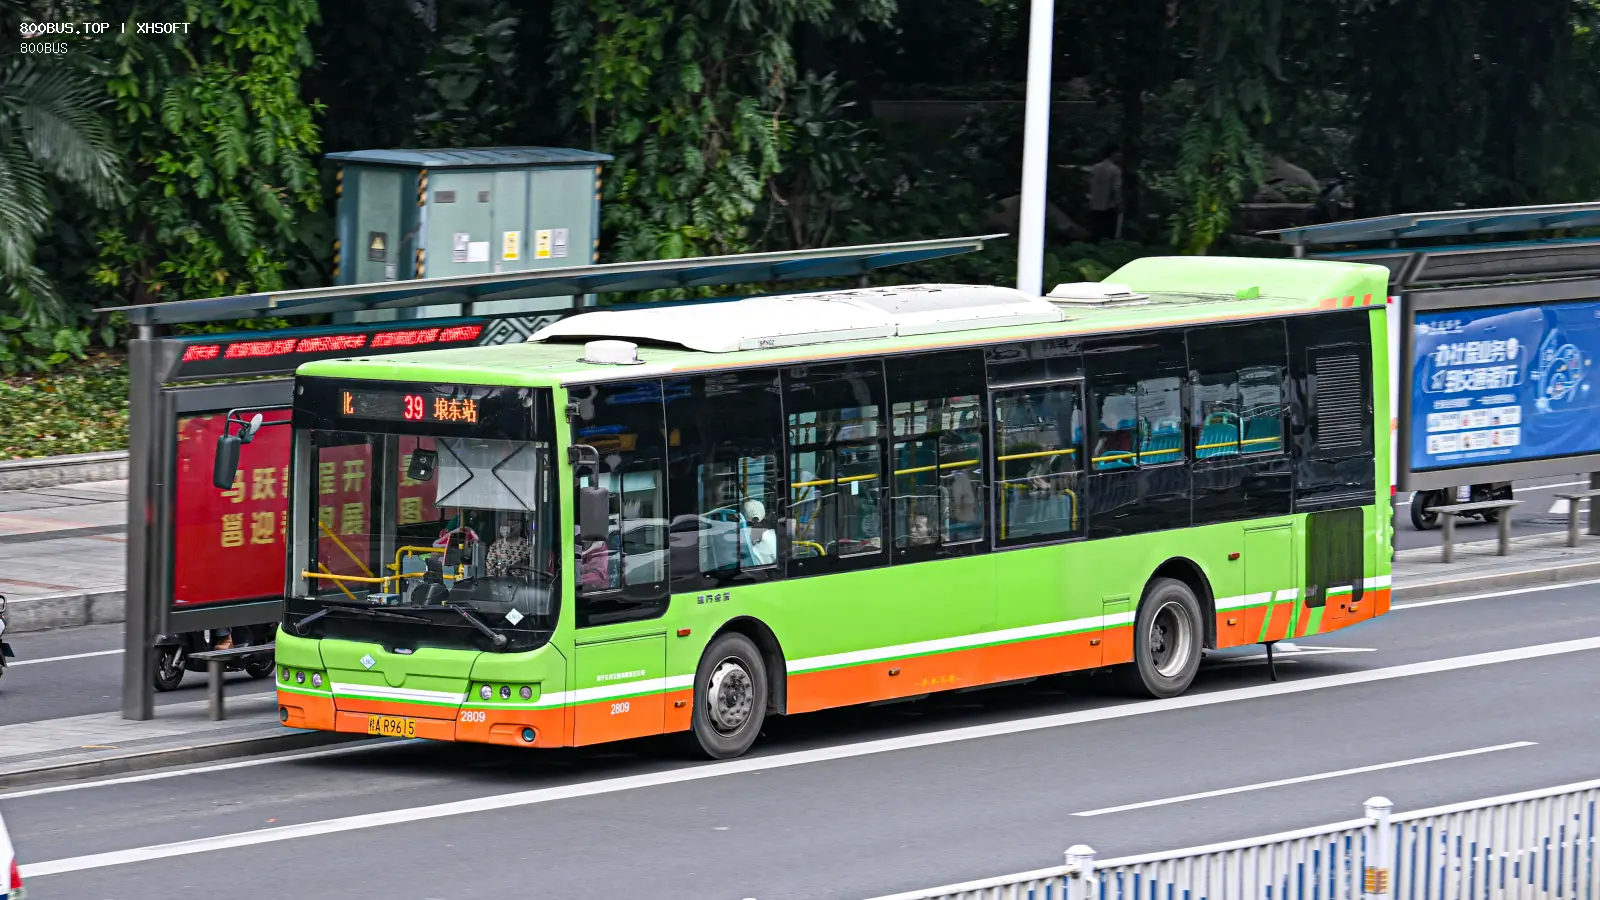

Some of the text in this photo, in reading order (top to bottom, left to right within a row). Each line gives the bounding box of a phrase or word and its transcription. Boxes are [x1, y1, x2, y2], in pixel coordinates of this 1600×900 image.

[404, 395, 425, 420] 39
[433, 397, 477, 423] 埌东站
[610, 701, 630, 715] 2809
[460, 710, 486, 723] 2809
